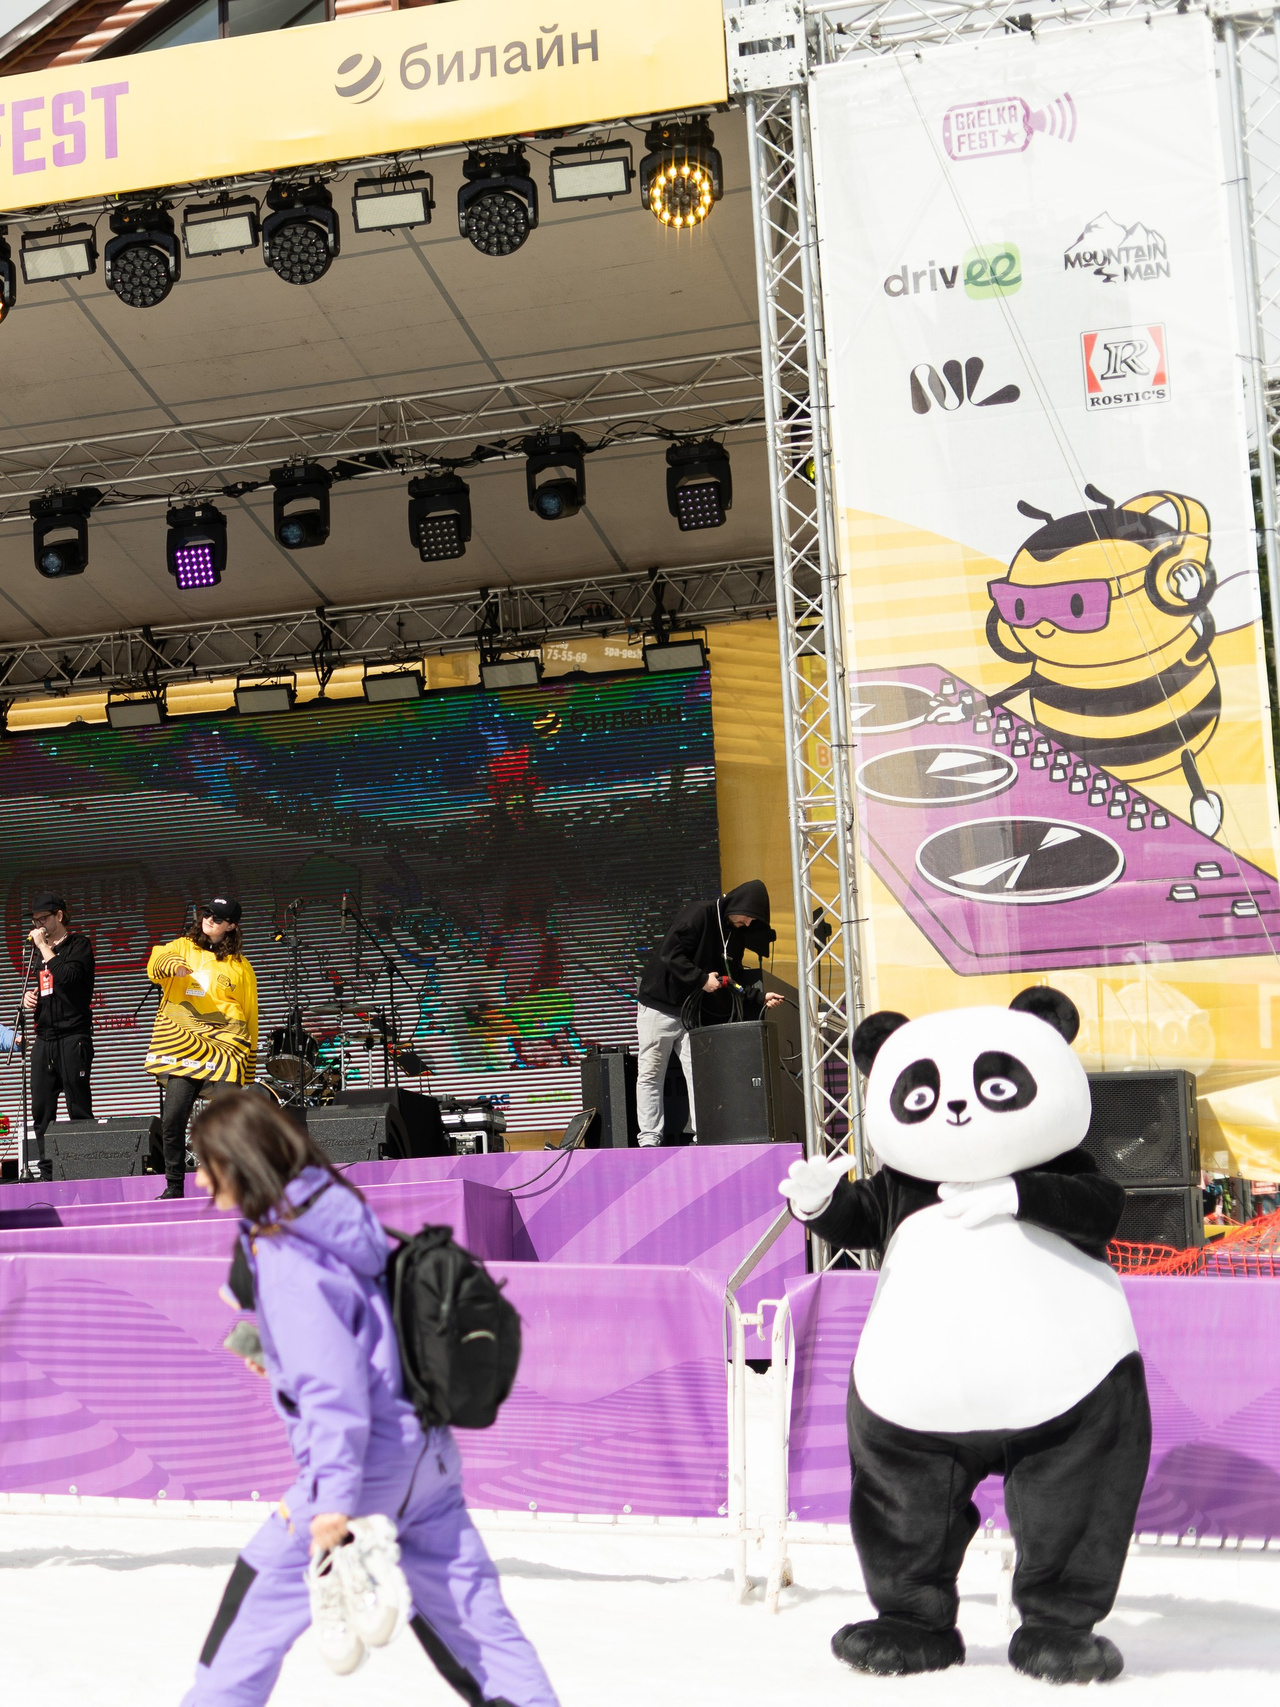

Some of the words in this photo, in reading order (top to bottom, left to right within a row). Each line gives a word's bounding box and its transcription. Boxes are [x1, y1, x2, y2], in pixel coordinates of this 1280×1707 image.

[399, 23, 599, 91] билайн
[955, 105, 1019, 131] GRELKA
[957, 129, 999, 153] FEST
[1063, 243, 1168, 272] MOUNTAIN
[883, 251, 1023, 298] drivee
[1123, 261, 1171, 283] MAN
[1089, 388, 1167, 408] ROSTIC'S
[546, 648, 588, 663] 75-55-69
[604, 646, 643, 660] spa-gesh
